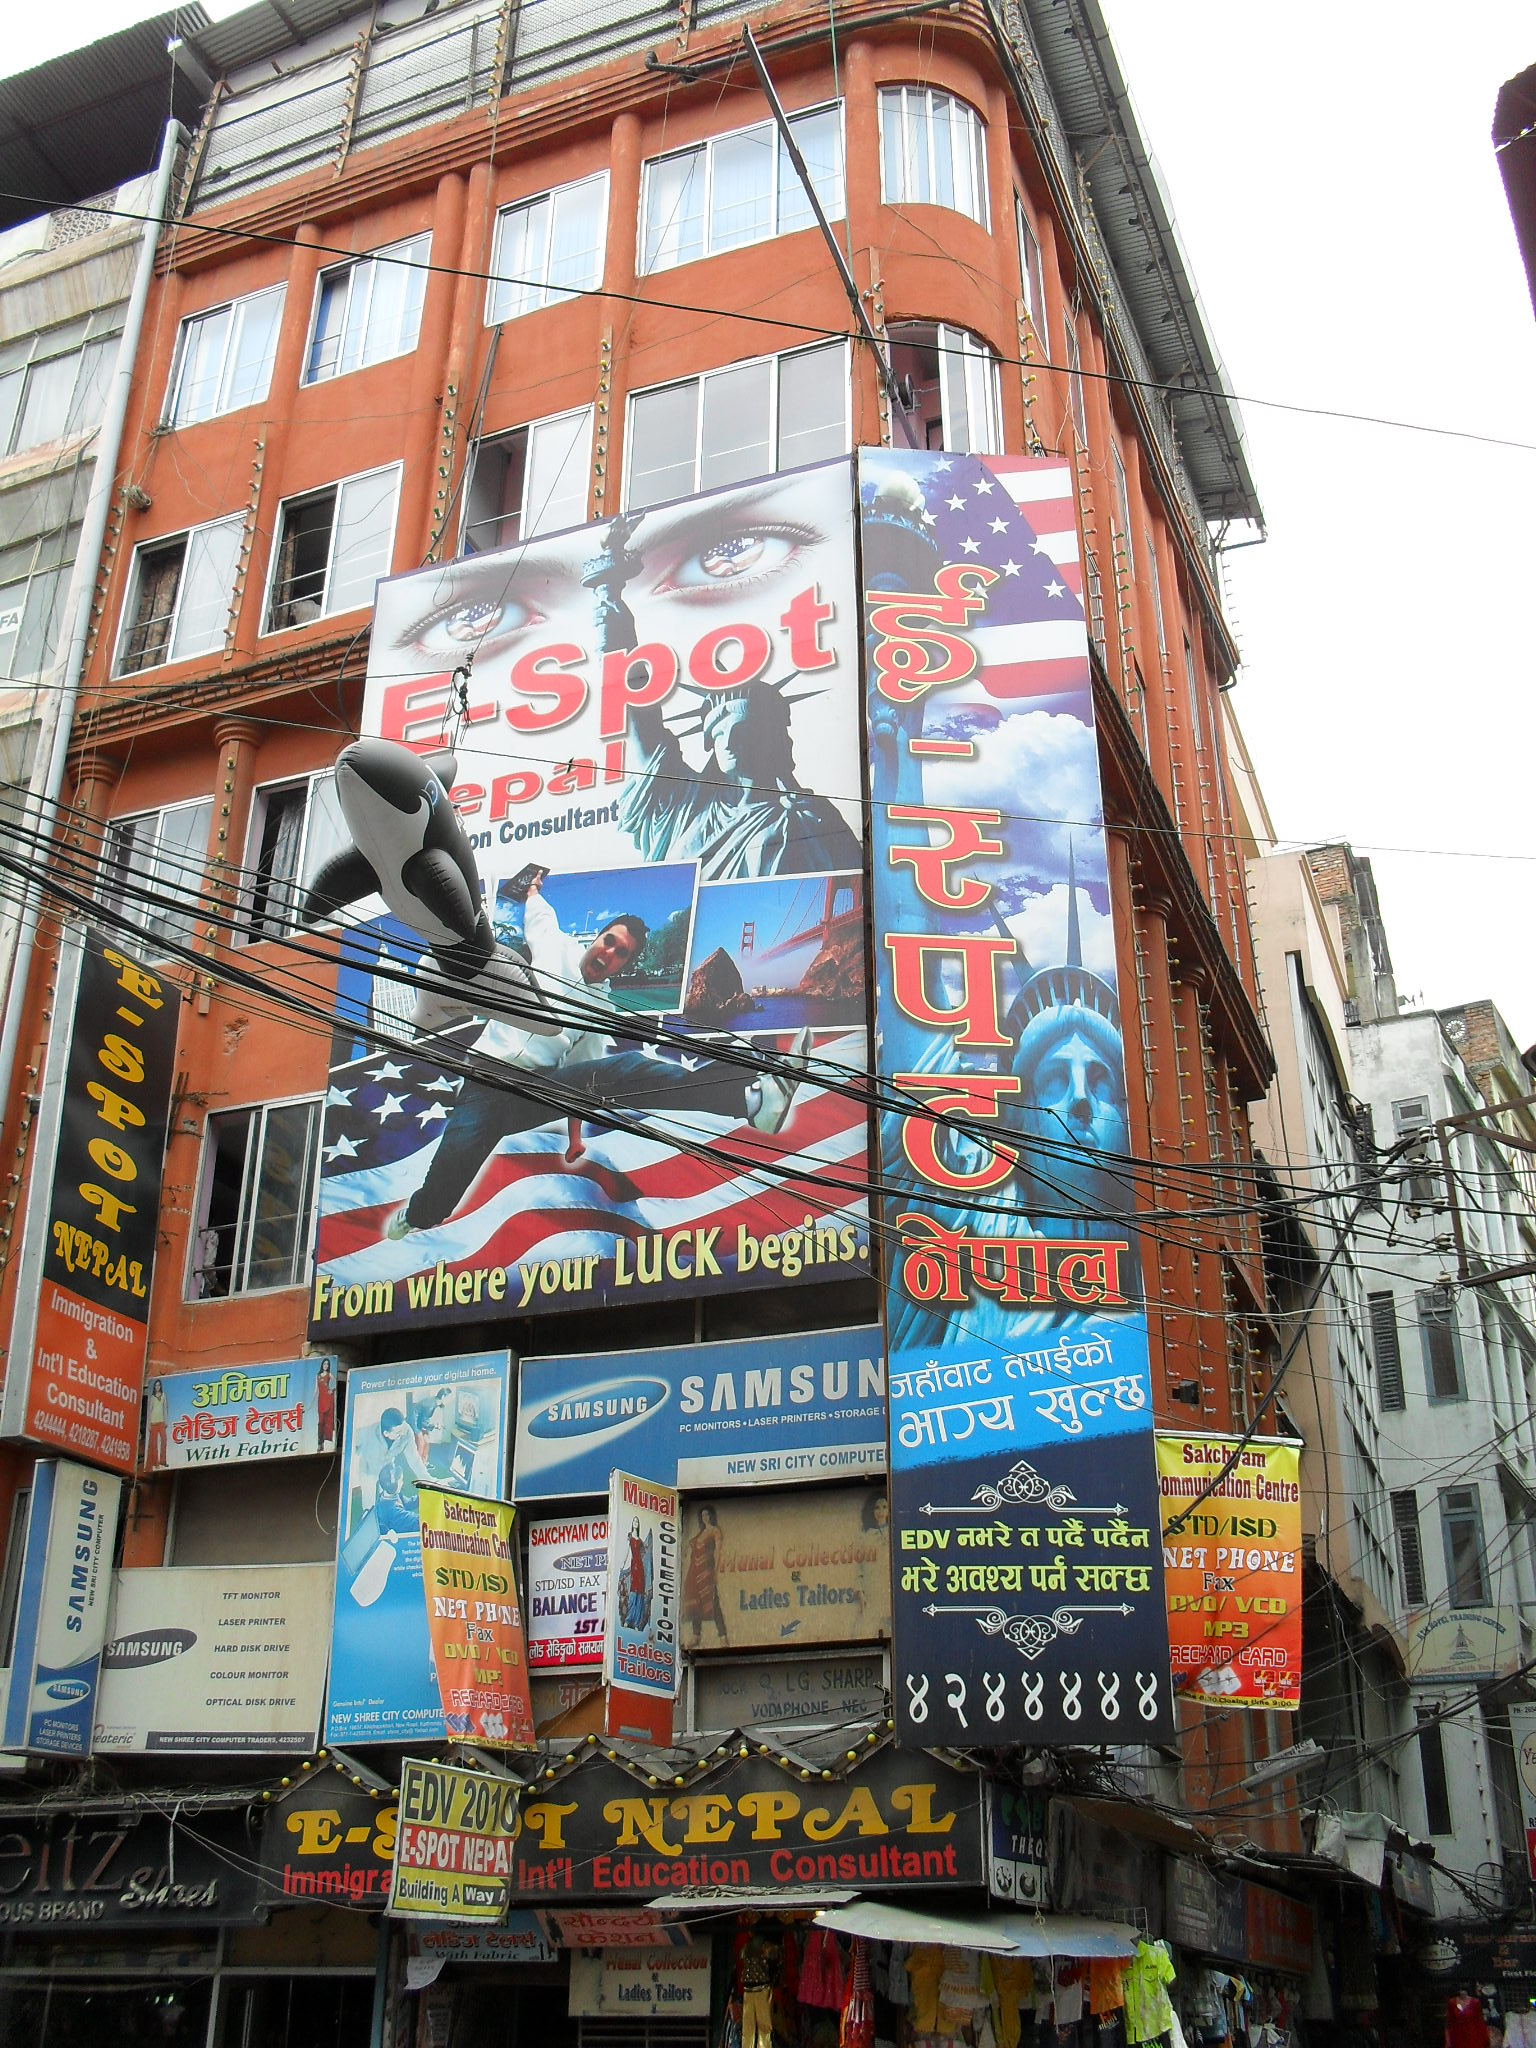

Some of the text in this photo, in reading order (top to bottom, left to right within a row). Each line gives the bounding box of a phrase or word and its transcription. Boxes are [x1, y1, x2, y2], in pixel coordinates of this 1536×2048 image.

[378, 582, 839, 756] E-Spot
[447, 742, 626, 822] epal
[500, 799, 620, 844] Consultant
[53, 1220, 148, 1299] NEPAL
[312, 1214, 869, 1322] From where your LUCK begins.
[896, 1212, 1130, 1305] नेपाल
[51, 1288, 134, 1344] Immigration
[86, 1337, 98, 1360] &
[37, 1347, 138, 1405] Int'l Education
[361, 1380, 385, 1390] Power
[387, 1378, 396, 1387] to
[397, 1376, 423, 1386] create
[424, 1373, 443, 1384] your
[444, 1368, 470, 1382] digital
[679, 1357, 887, 1415] SAMSUN
[192, 1371, 290, 1409] अमिना
[47, 1382, 125, 1431] Consultant
[547, 1396, 648, 1422] SAMSUNG
[679, 1423, 692, 1433] PC
[693, 1419, 742, 1432] MONITORS
[748, 1416, 779, 1428] LASER
[780, 1411, 827, 1424] PRINTERS
[834, 1407, 880, 1419] STORAGE
[898, 1394, 1015, 1449] भाग्य
[186, 1437, 300, 1463] With Fabric
[727, 1449, 887, 1475] NEW SRI CITY COMPUTE
[623, 1479, 676, 1518] Munal
[1158, 1470, 1299, 1503] ommunication Centre
[443, 1499, 498, 1529] Sakchyam
[1167, 1514, 1278, 1539] STD/ISD
[94, 1514, 105, 1555] COMPUTER
[421, 1521, 492, 1557] Communication
[531, 1523, 589, 1547] SAKCHYAM
[901, 1529, 951, 1550] EDV
[956, 1520, 1013, 1548] नभरे
[1018, 1527, 1041, 1548] त
[66, 1479, 98, 1633] SAMSUNG
[560, 1554, 593, 1570] NET
[781, 1543, 878, 1569] Collection
[1163, 1546, 1295, 1574] NET PHONE
[535, 1574, 600, 1592] STD/ISD FAX
[657, 1520, 677, 1645] COLLECTION
[901, 1556, 940, 1593] भरे
[946, 1563, 1024, 1593] अवश्य
[1203, 1571, 1235, 1592] Fax
[222, 1591, 281, 1600] TFT MONITOR
[532, 1591, 598, 1618] BALANCE
[739, 1582, 856, 1611] Ladies Tailors
[1235, 1596, 1287, 1615] VCD
[218, 1617, 286, 1626] LASER PRINTER
[432, 1595, 520, 1628] NET PHNE
[466, 1621, 495, 1643] Fax
[573, 1619, 600, 1635] 1ST
[1203, 1620, 1249, 1639] MP3
[106, 1641, 183, 1657] SAMSUNG
[214, 1643, 291, 1653] HARD DISK DRIVE
[443, 1643, 481, 1660] DVD
[616, 1635, 674, 1666] Ladies
[1238, 1646, 1288, 1668] CARD
[210, 1671, 290, 1680] COLOUR MONITOR
[616, 1656, 671, 1684] Tailors
[786, 1670, 811, 1692] LG
[821, 1667, 875, 1691] SHARP
[52, 1683, 84, 1697] SAMSUNG
[206, 1698, 297, 1707] OPTICAL DISK DRIVE
[906, 1671, 1159, 1729] ४२४४४४४
[331, 1708, 444, 1724] NEW SHREE CITY COMPUTE
[751, 1698, 868, 1718] VODAPHONE NEC
[39, 1728, 82, 1742] LASER PRINTERS
[52, 1720, 79, 1732] MONITORS
[174, 1736, 195, 1744] SHREE
[196, 1736, 211, 1744] CITY
[211, 1736, 246, 1744] COMPUTER
[404, 1767, 521, 1834] EDV 2010
[603, 1783, 957, 1858] NEPAL
[400, 1827, 461, 1869] E-SPOT
[518, 1843, 958, 1891] Int'l Education Consultant
[398, 1877, 449, 1907] Building
[451, 1883, 460, 1903] A
[465, 1886, 496, 1908] Way
[38, 1900, 105, 1921] BRAND
[473, 1950, 521, 1960] Fabric
[645, 1952, 708, 1971] Collection
[618, 1983, 693, 2001] Ladies Tailors
